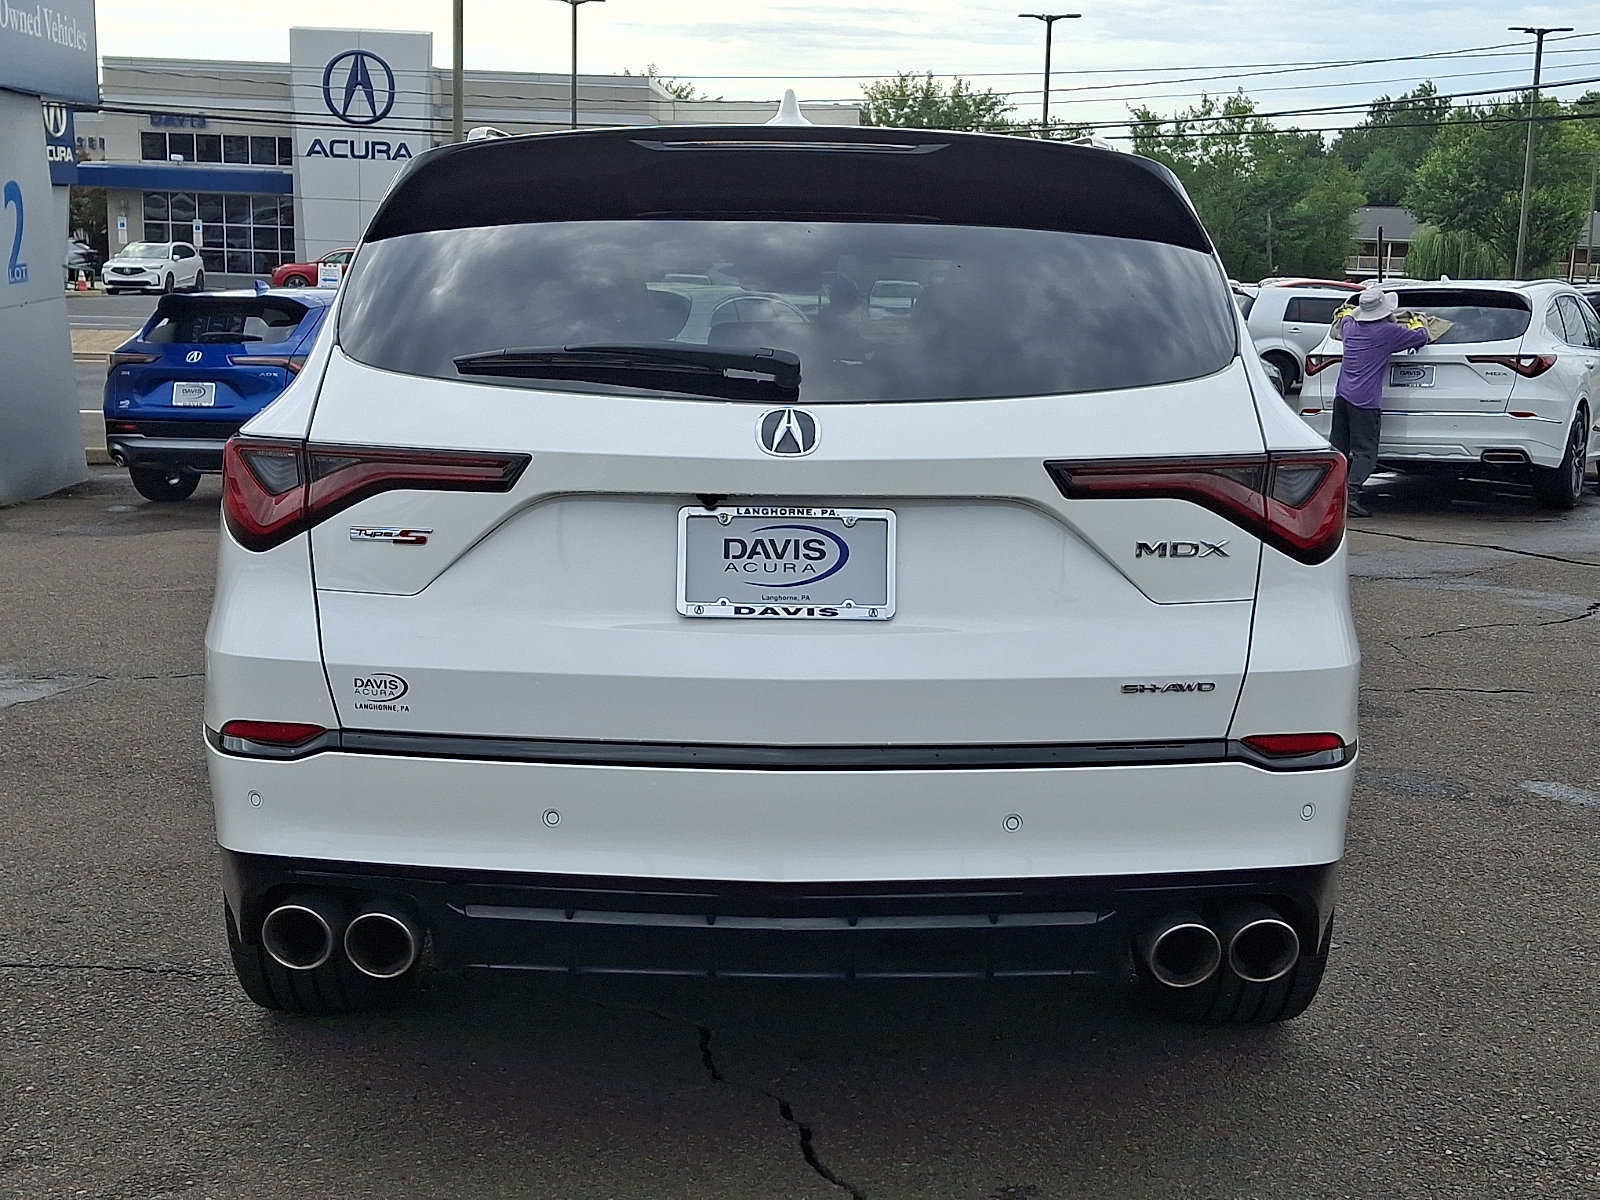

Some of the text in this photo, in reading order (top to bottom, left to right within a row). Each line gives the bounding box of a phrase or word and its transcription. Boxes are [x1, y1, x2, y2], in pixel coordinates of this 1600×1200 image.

[0, 0, 87, 51] Owned Vehicles
[46, 145, 74, 162] CURA
[306, 138, 413, 160] ACURA
[4, 180, 28, 284] 2
[9, 266, 27, 281] LOT
[736, 507, 840, 517] LANGHORNE, PA.
[354, 528, 433, 545] Type S
[723, 538, 827, 561] DAVIS
[1135, 540, 1230, 558] MDX
[724, 562, 817, 573] ACURA
[761, 594, 799, 602] Langhorne,
[734, 606, 839, 617] DAVIS
[354, 678, 398, 690] DAVIS
[354, 688, 396, 697] ACURA
[354, 702, 399, 712] LANGHORNE,
